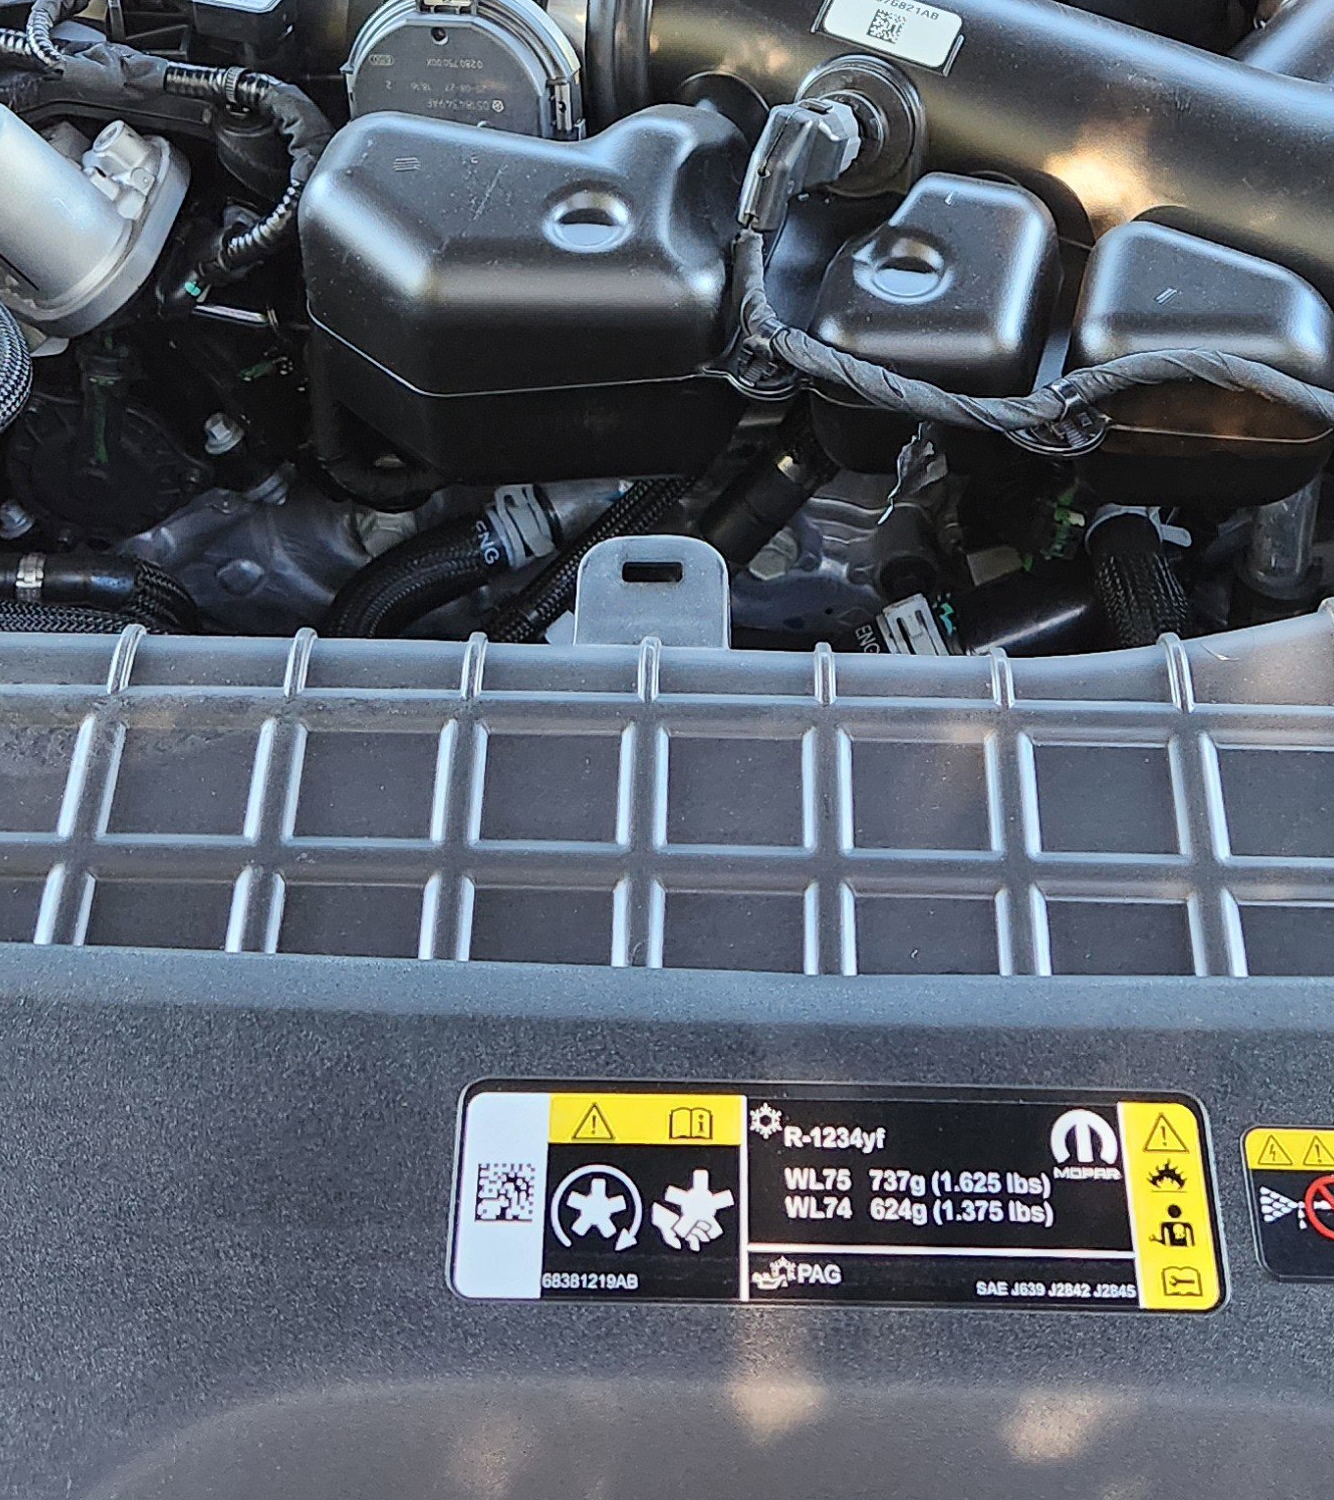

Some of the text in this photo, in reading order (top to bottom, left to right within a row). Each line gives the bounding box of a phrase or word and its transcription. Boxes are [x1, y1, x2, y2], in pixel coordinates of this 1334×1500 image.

[783, 1125, 887, 1154] R-1234yf
[783, 1167, 1052, 1200] WL75 737g (1.625 lbs)
[1053, 1166, 1121, 1180] MOPAR
[784, 1195, 1055, 1228] WL74 624g (1.375 lbs)
[541, 1272, 639, 1290] 68381219AB
[796, 1263, 843, 1285] PAG
[975, 1280, 1137, 1299] SAE J639 J2842 J2845
